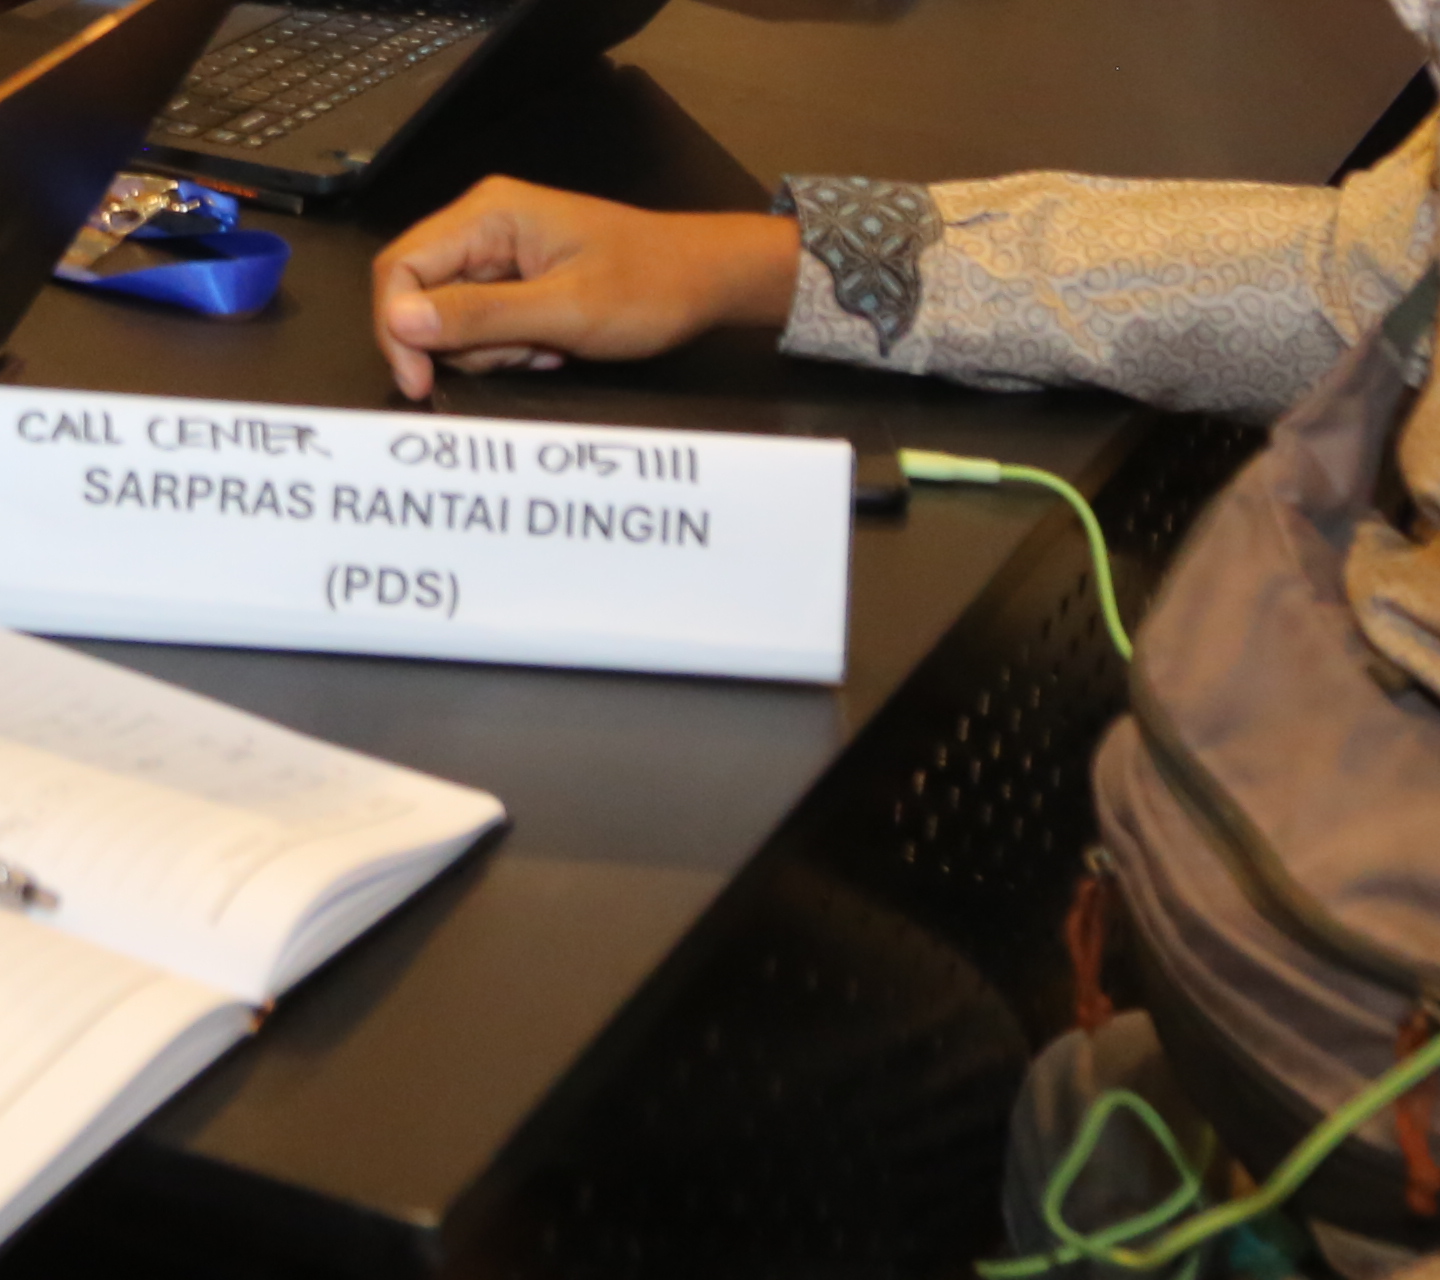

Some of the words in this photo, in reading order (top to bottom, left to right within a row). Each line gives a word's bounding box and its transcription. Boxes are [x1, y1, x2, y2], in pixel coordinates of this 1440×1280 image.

[17, 409, 123, 445] CALL
[147, 415, 333, 458] CENTER
[83, 466, 315, 520] SARPRAS
[332, 484, 509, 533] RANTAI
[526, 497, 710, 548] DINGIN
[326, 563, 461, 620] (PDS)
